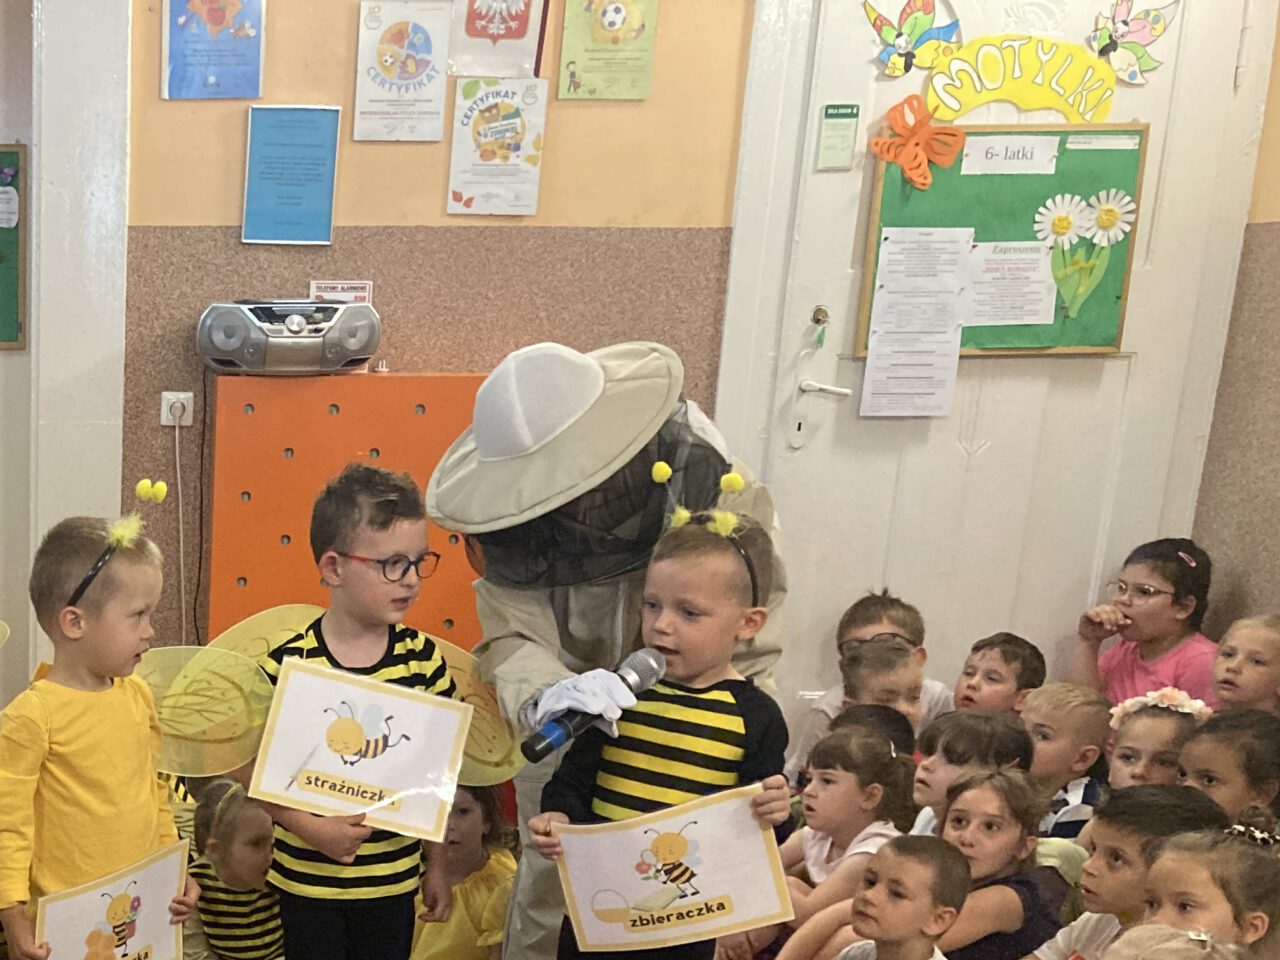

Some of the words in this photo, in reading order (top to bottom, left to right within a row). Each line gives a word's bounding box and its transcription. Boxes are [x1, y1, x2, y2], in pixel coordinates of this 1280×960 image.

[366, 63, 441, 94] CERTYFIKAT
[931, 36, 1114, 123] MOTYLKI
[460, 89, 518, 127] CERTYFIKAT
[1003, 145, 1035, 161] latki
[629, 901, 726, 928] zbieraczka
